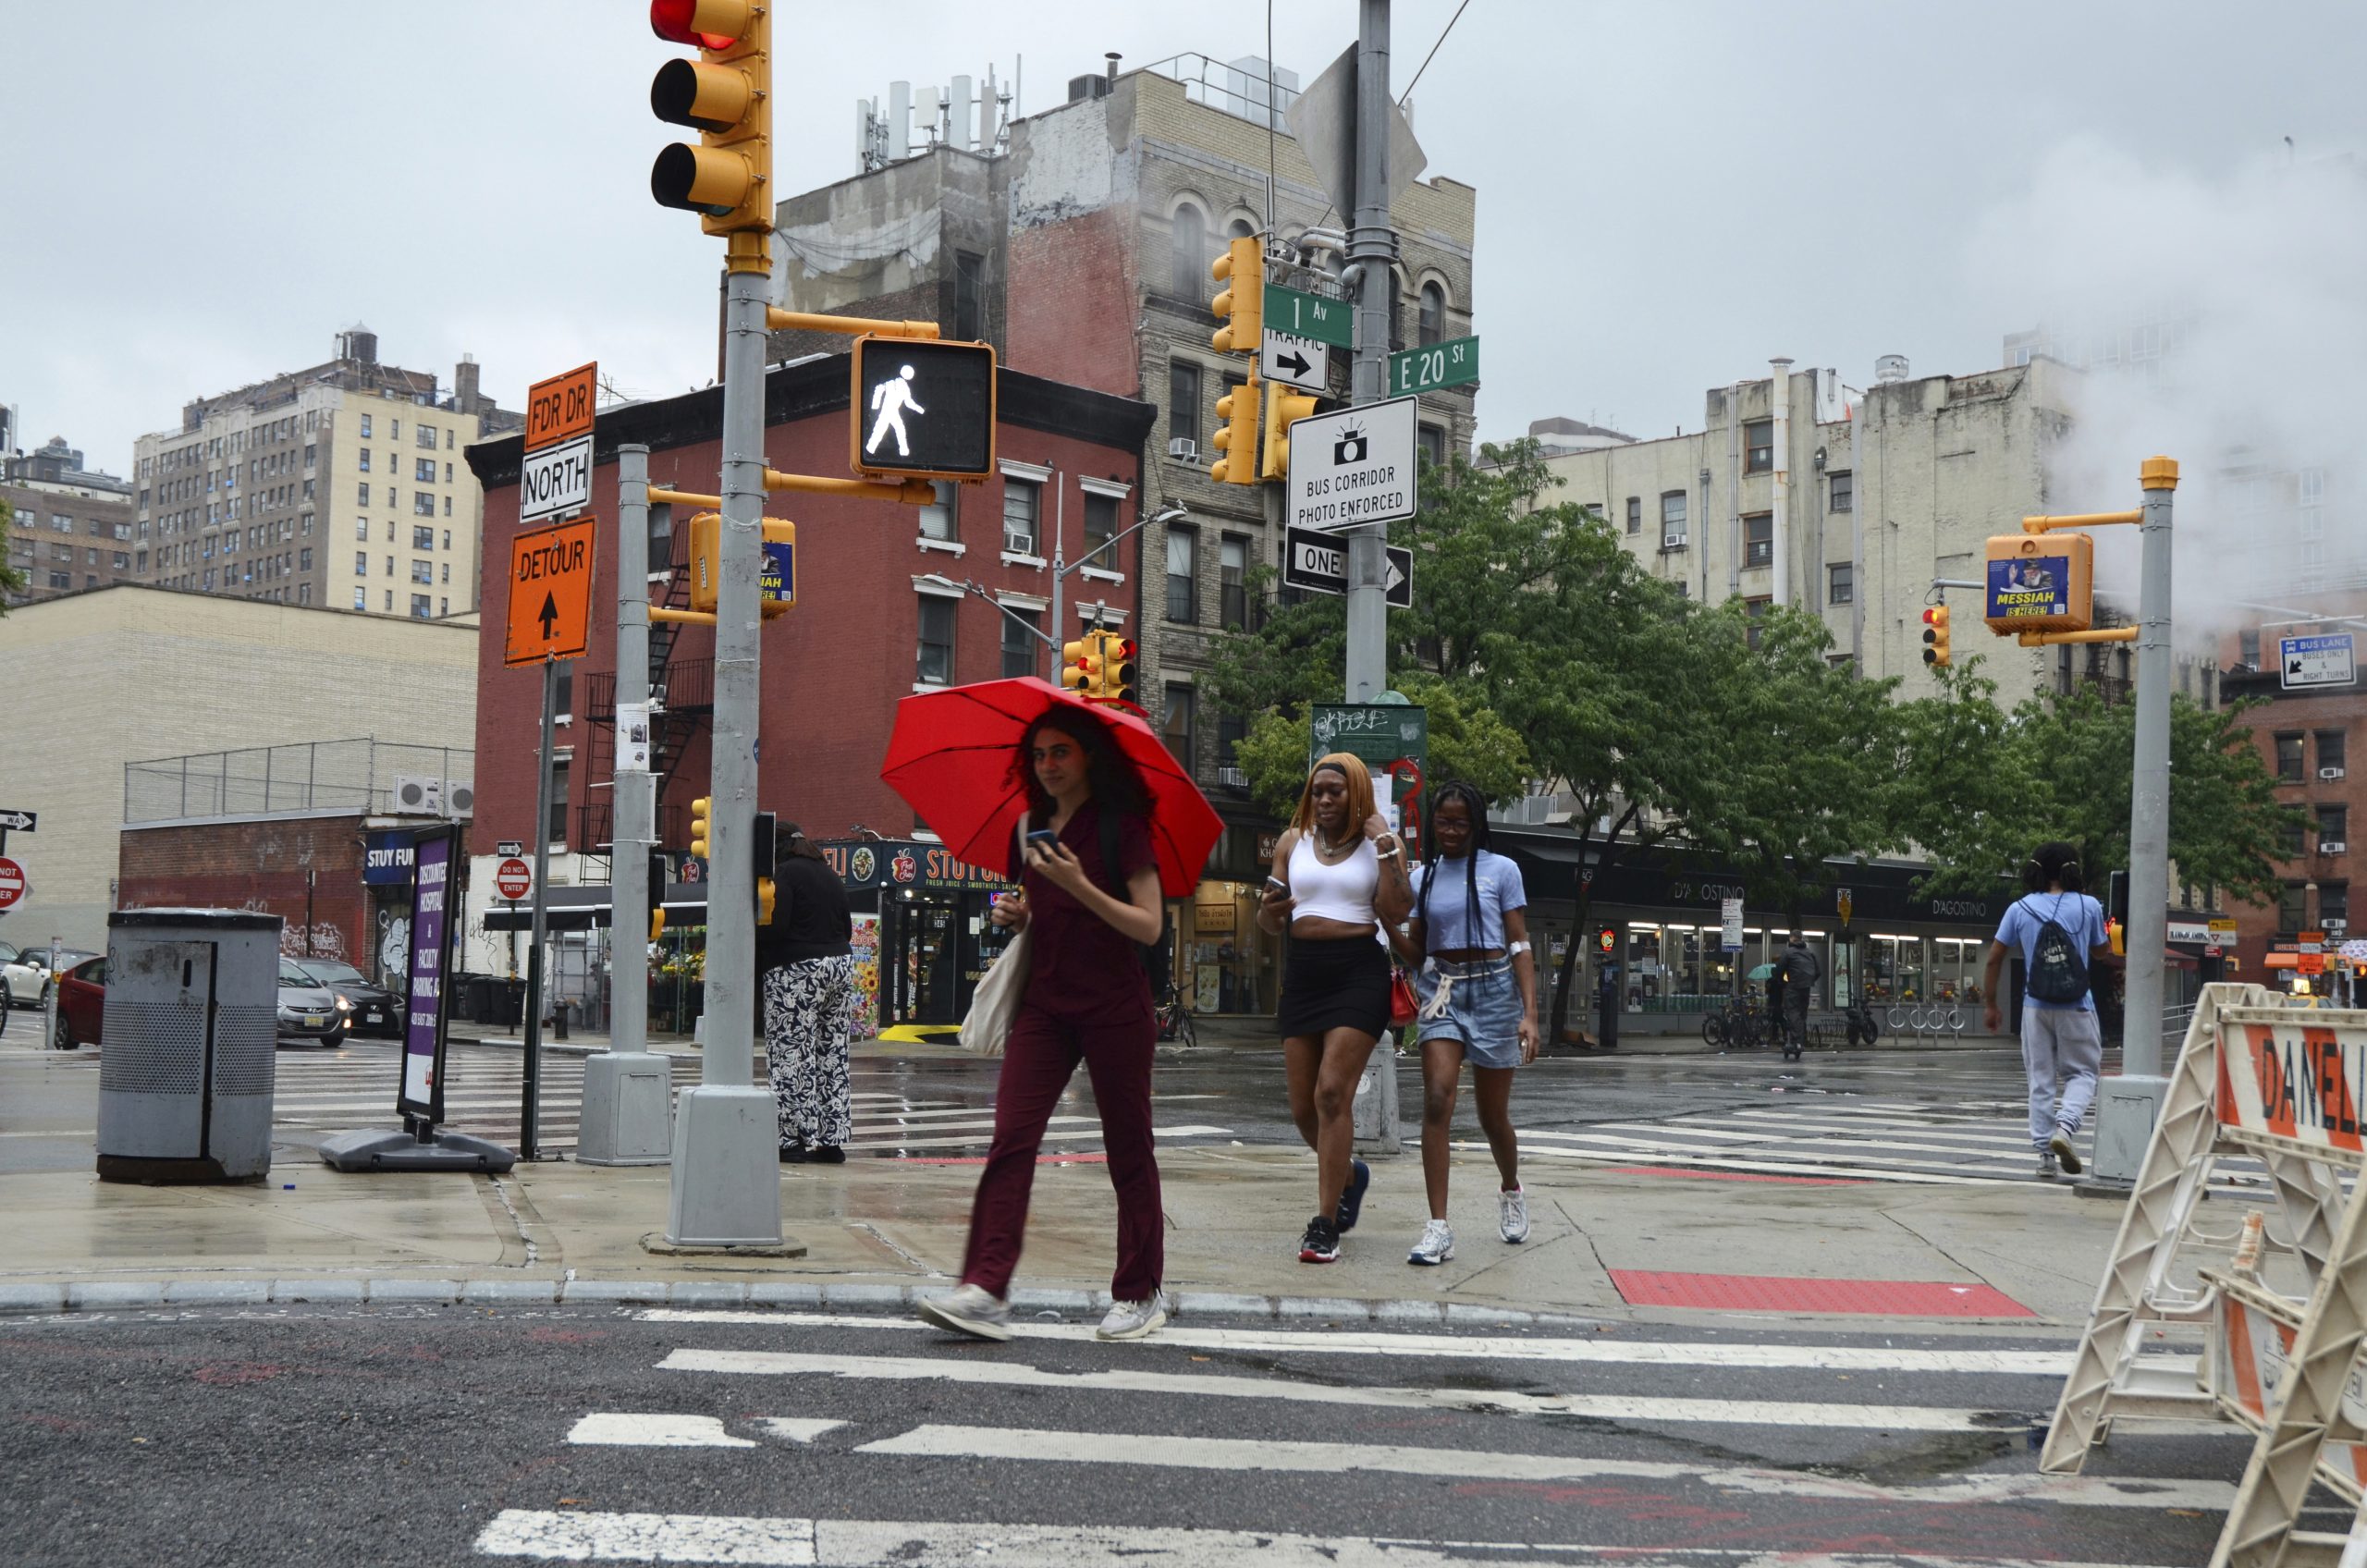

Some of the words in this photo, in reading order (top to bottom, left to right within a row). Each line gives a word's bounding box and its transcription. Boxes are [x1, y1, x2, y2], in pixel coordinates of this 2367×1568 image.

[1294, 297, 1300, 329] 1
[1313, 301, 1328, 322] Av
[1401, 356, 1412, 390] E
[1419, 349, 1445, 386] 20
[1453, 344, 1465, 363] St
[532, 392, 562, 435] FDR
[566, 383, 590, 424] DR.
[524, 453, 588, 506] NORTH
[1306, 478, 1330, 497] BUS
[1335, 466, 1395, 492] CORRIDOR
[1298, 503, 1336, 525] PHOTO
[1340, 491, 1404, 518] ENFORCED
[520, 539, 585, 582] DETOUR
[1305, 547, 1341, 575] ONE
[1997, 592, 2054, 606] MESSIAH
[2006, 607, 2017, 617] IS
[2018, 606, 2047, 617] HERE!
[2300, 641, 2319, 650] BUS
[2322, 638, 2349, 648] LANE
[2302, 652, 2324, 660] BUSES
[2327, 650, 2344, 658] ONLY
[2303, 672, 2323, 680] RIGHT
[2326, 670, 2349, 679] TURNS
[7, 816, 27, 826] WAY
[368, 849, 395, 868] STUY
[504, 884, 523, 892] ENTER
[926, 878, 943, 887] FRESH
[946, 879, 961, 888] JUICE
[1674, 882, 1745, 901] D'AOSTINO
[420, 891, 443, 913] HOSPITAL
[1933, 900, 1987, 917] D'AGOSTINO
[427, 924, 432, 938] &
[418, 949, 438, 969] FACULTY
[412, 977, 433, 997] PARKING
